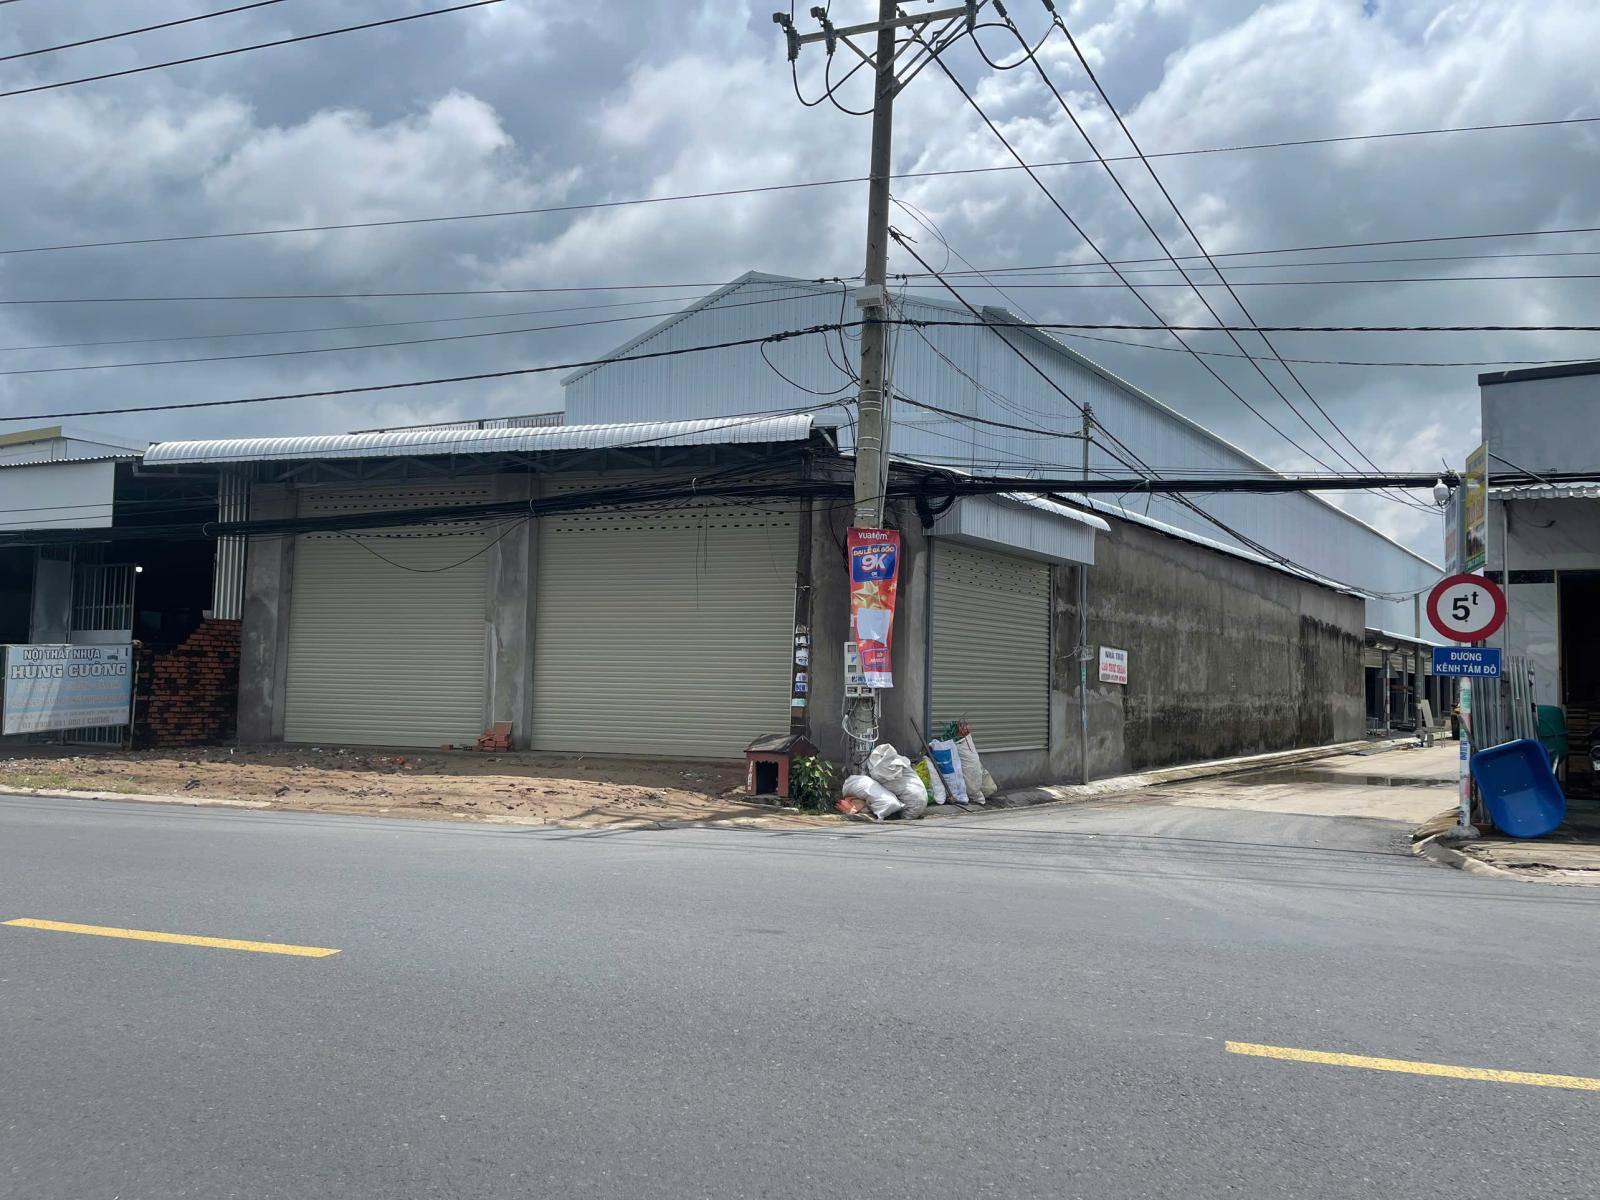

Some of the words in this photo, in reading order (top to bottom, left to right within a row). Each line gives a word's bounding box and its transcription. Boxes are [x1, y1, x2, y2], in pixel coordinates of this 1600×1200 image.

[861, 553, 887, 572] 9K
[23, 648, 43, 663] NỘI
[45, 647, 70, 661] THẤT
[73, 648, 101, 661] NHỰA
[1450, 650, 1482, 662] ĐƯỜNG
[68, 660, 127, 677] CƯỜNG
[1436, 661, 1461, 673] KÊNH
[1462, 662, 1481, 674] TÁM
